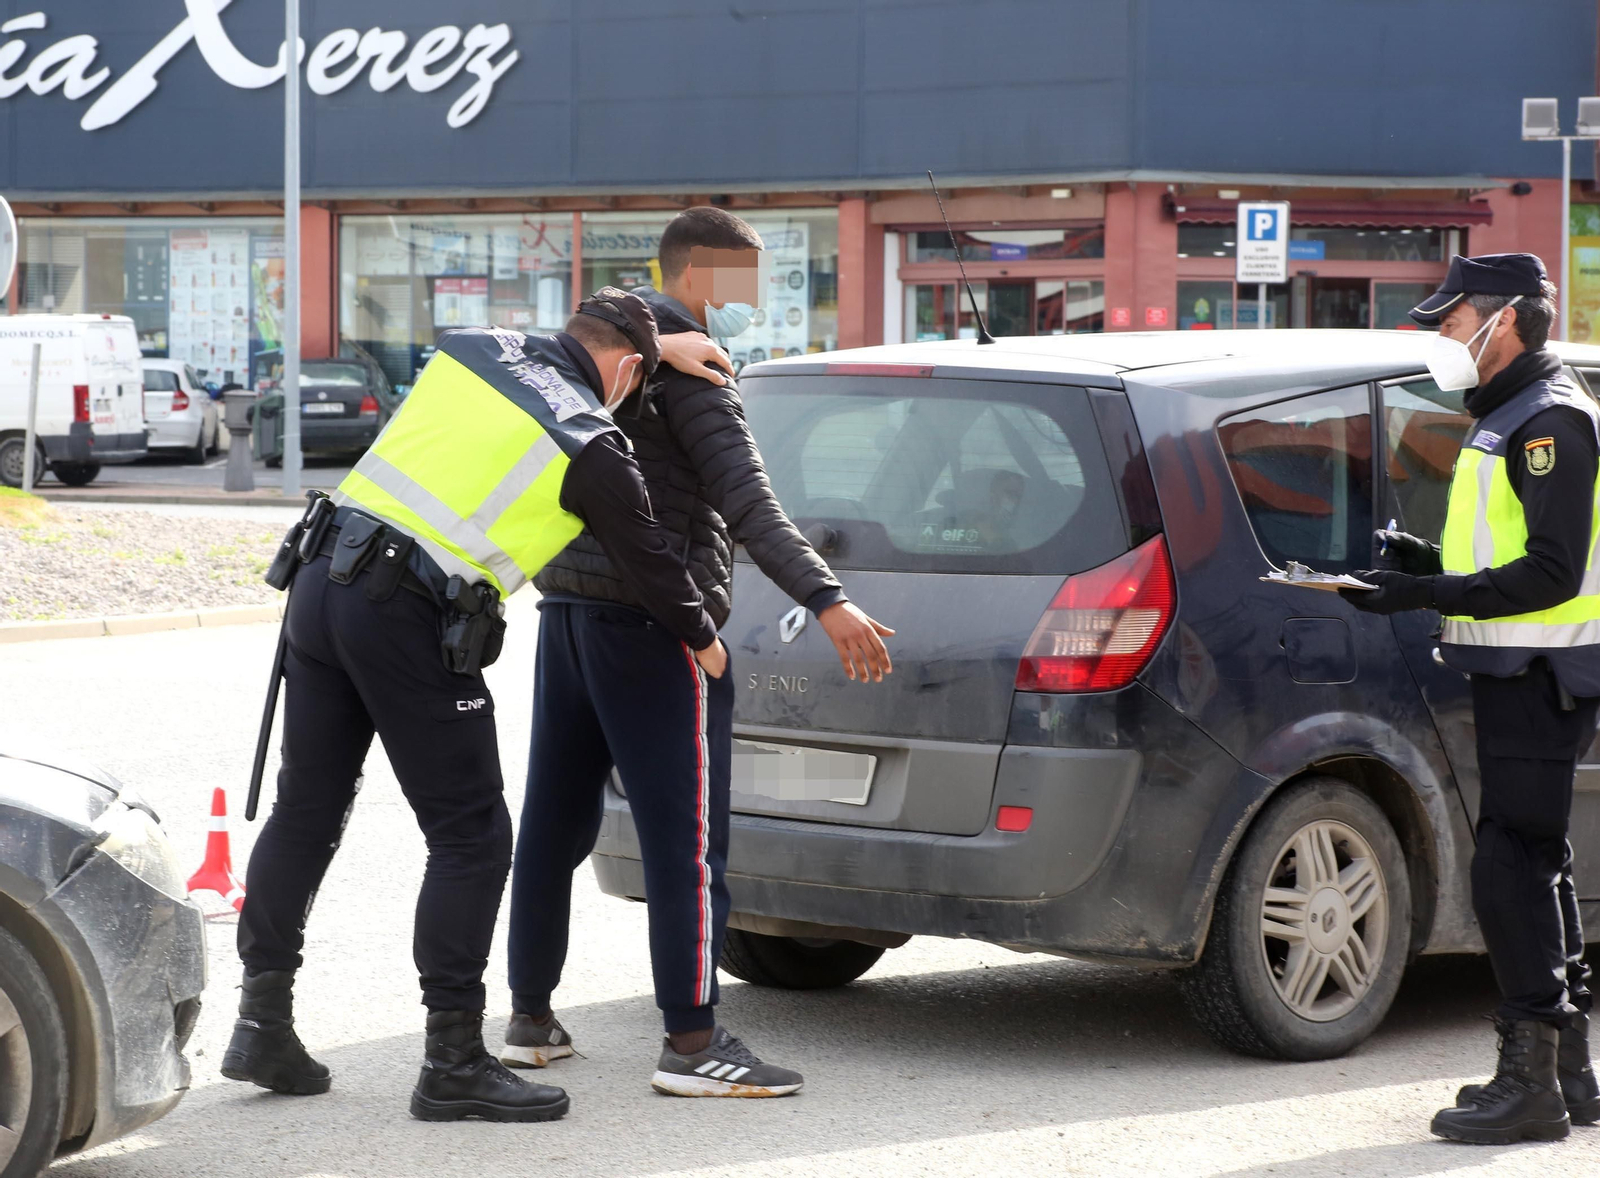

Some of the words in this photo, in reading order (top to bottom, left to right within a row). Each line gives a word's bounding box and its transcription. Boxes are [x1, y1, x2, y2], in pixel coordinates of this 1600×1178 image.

[80, 0, 518, 131] Xerez
[1254, 213, 1273, 239] P
[563, 397, 582, 410] DE
[942, 529, 965, 541] elf
[456, 698, 486, 711] CNP
